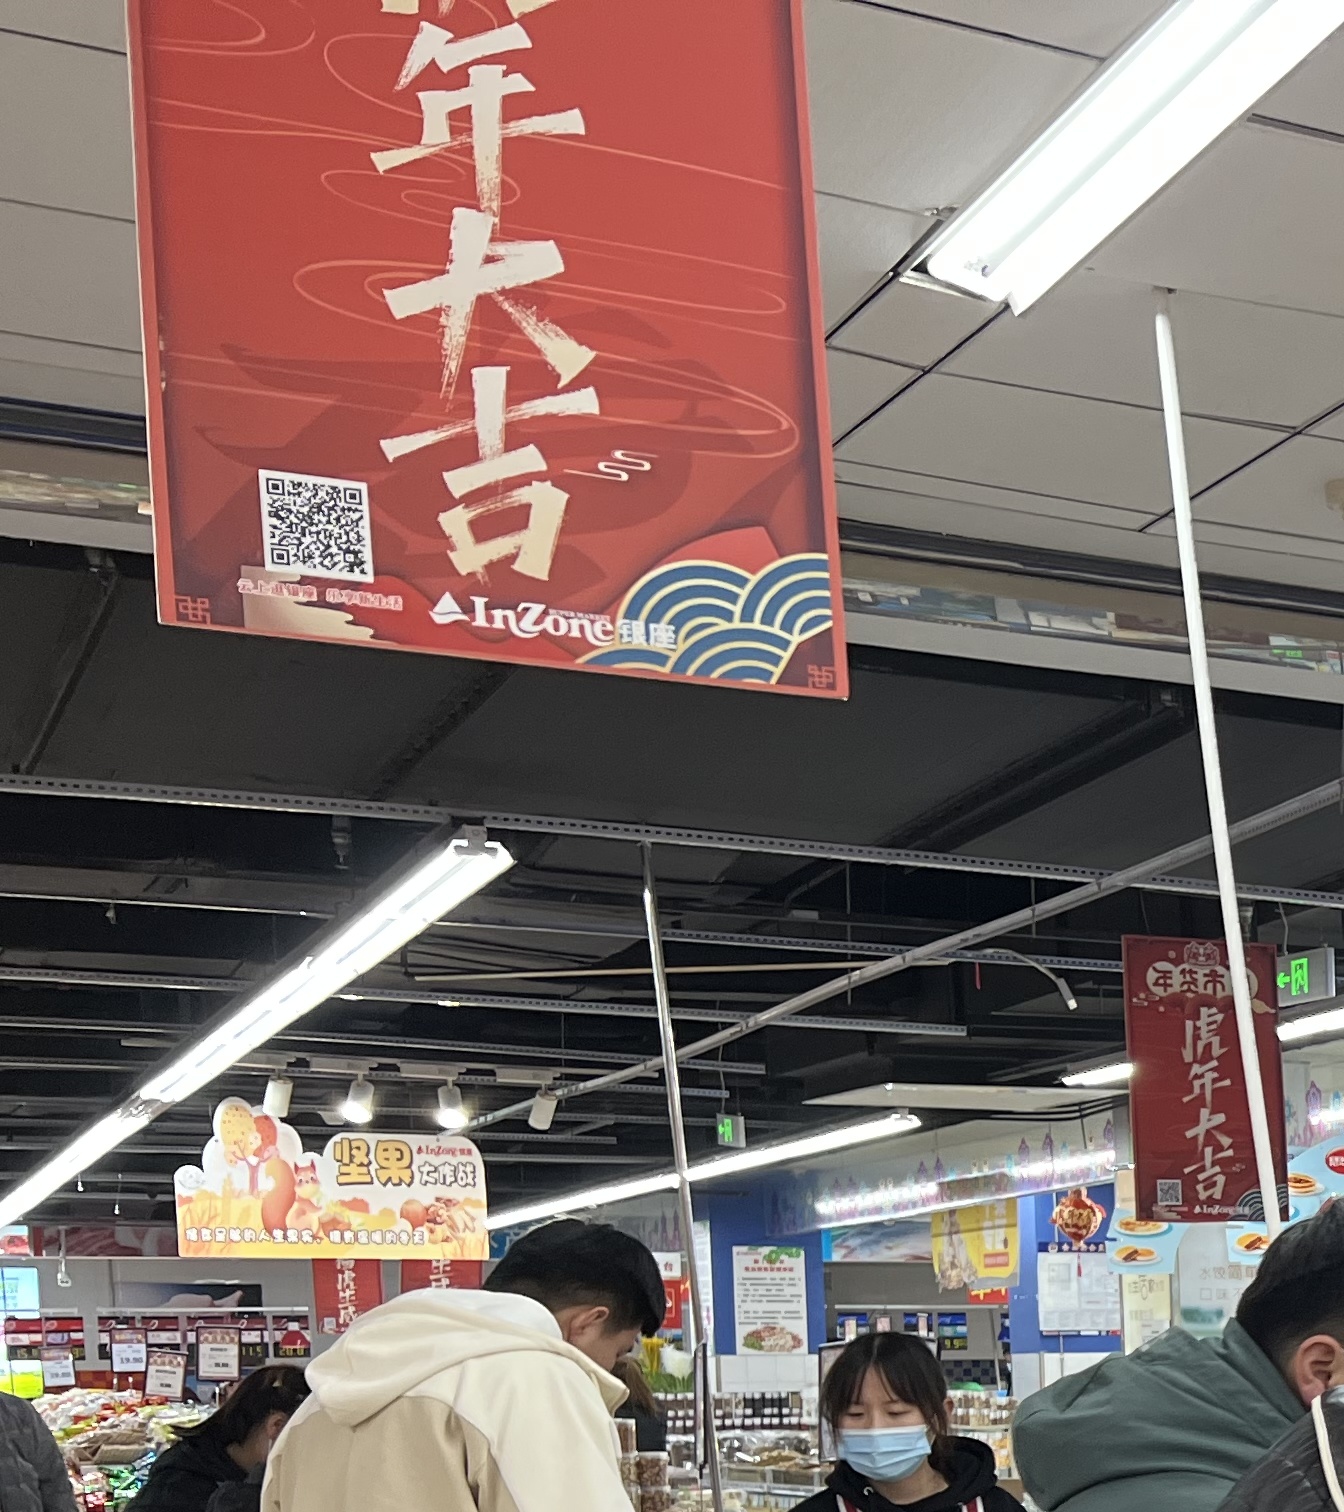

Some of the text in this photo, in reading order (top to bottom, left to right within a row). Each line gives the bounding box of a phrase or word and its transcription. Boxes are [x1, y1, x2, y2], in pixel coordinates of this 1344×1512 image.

[371, 0, 600, 585] 年大吉
[469, 595, 678, 650] InZone 银座
[1152, 966, 1226, 995] 年货市
[1181, 1006, 1234, 1200] 虎年大吉
[334, 1138, 414, 1187] 坚果
[418, 1162, 476, 1188] 大作战
